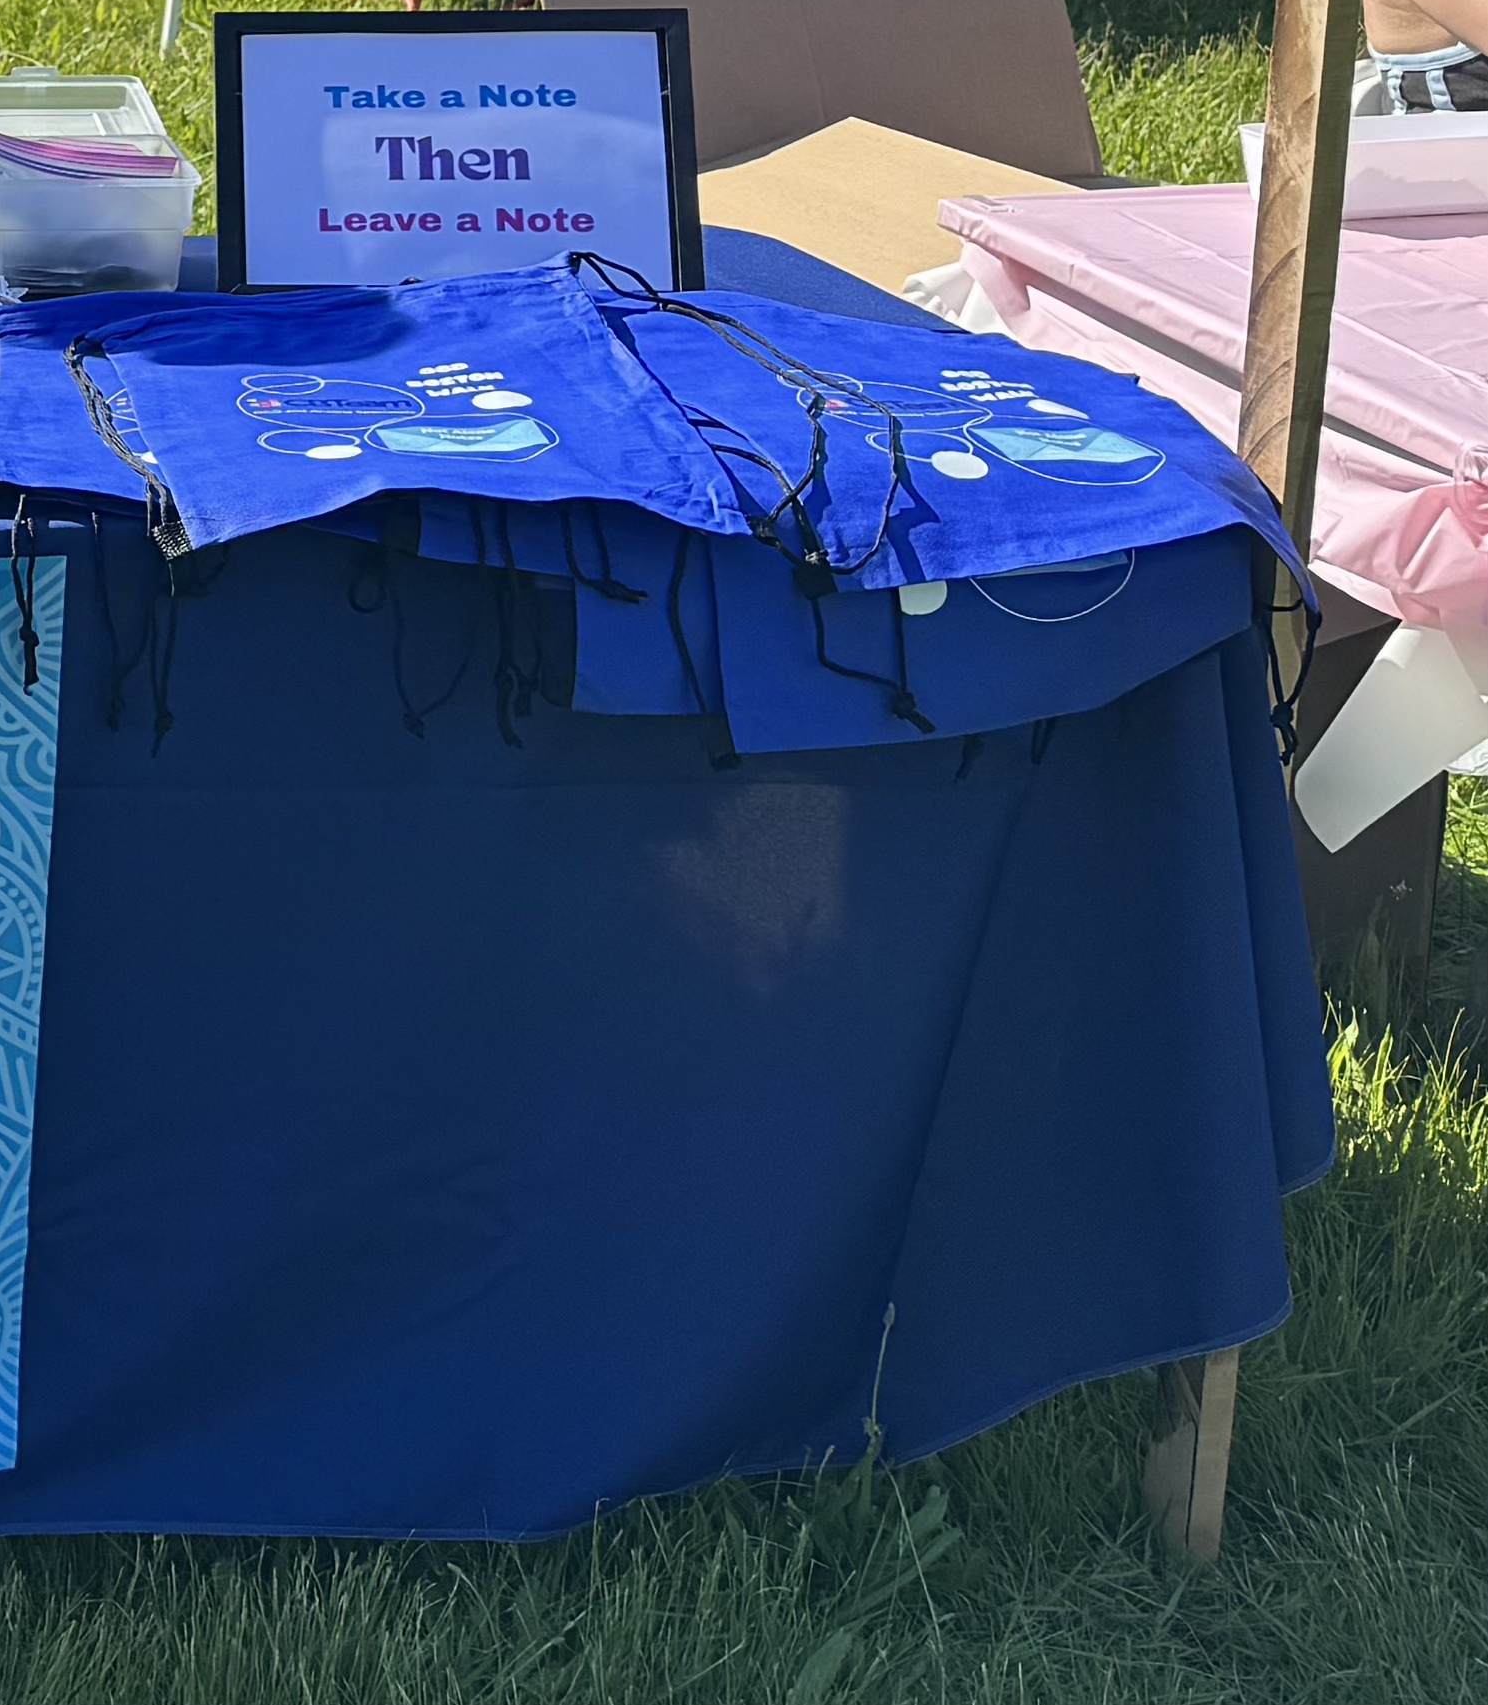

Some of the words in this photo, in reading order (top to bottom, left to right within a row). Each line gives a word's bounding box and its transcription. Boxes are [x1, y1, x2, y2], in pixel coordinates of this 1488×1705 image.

[324, 84, 426, 109] Take
[440, 89, 466, 109] a
[479, 83, 578, 108] Note
[374, 134, 531, 182] Then
[318, 207, 442, 233] Leave
[456, 212, 482, 233] a
[496, 206, 596, 233] Note
[406, 371, 504, 388] BOSTON
[425, 384, 495, 397] WALK
